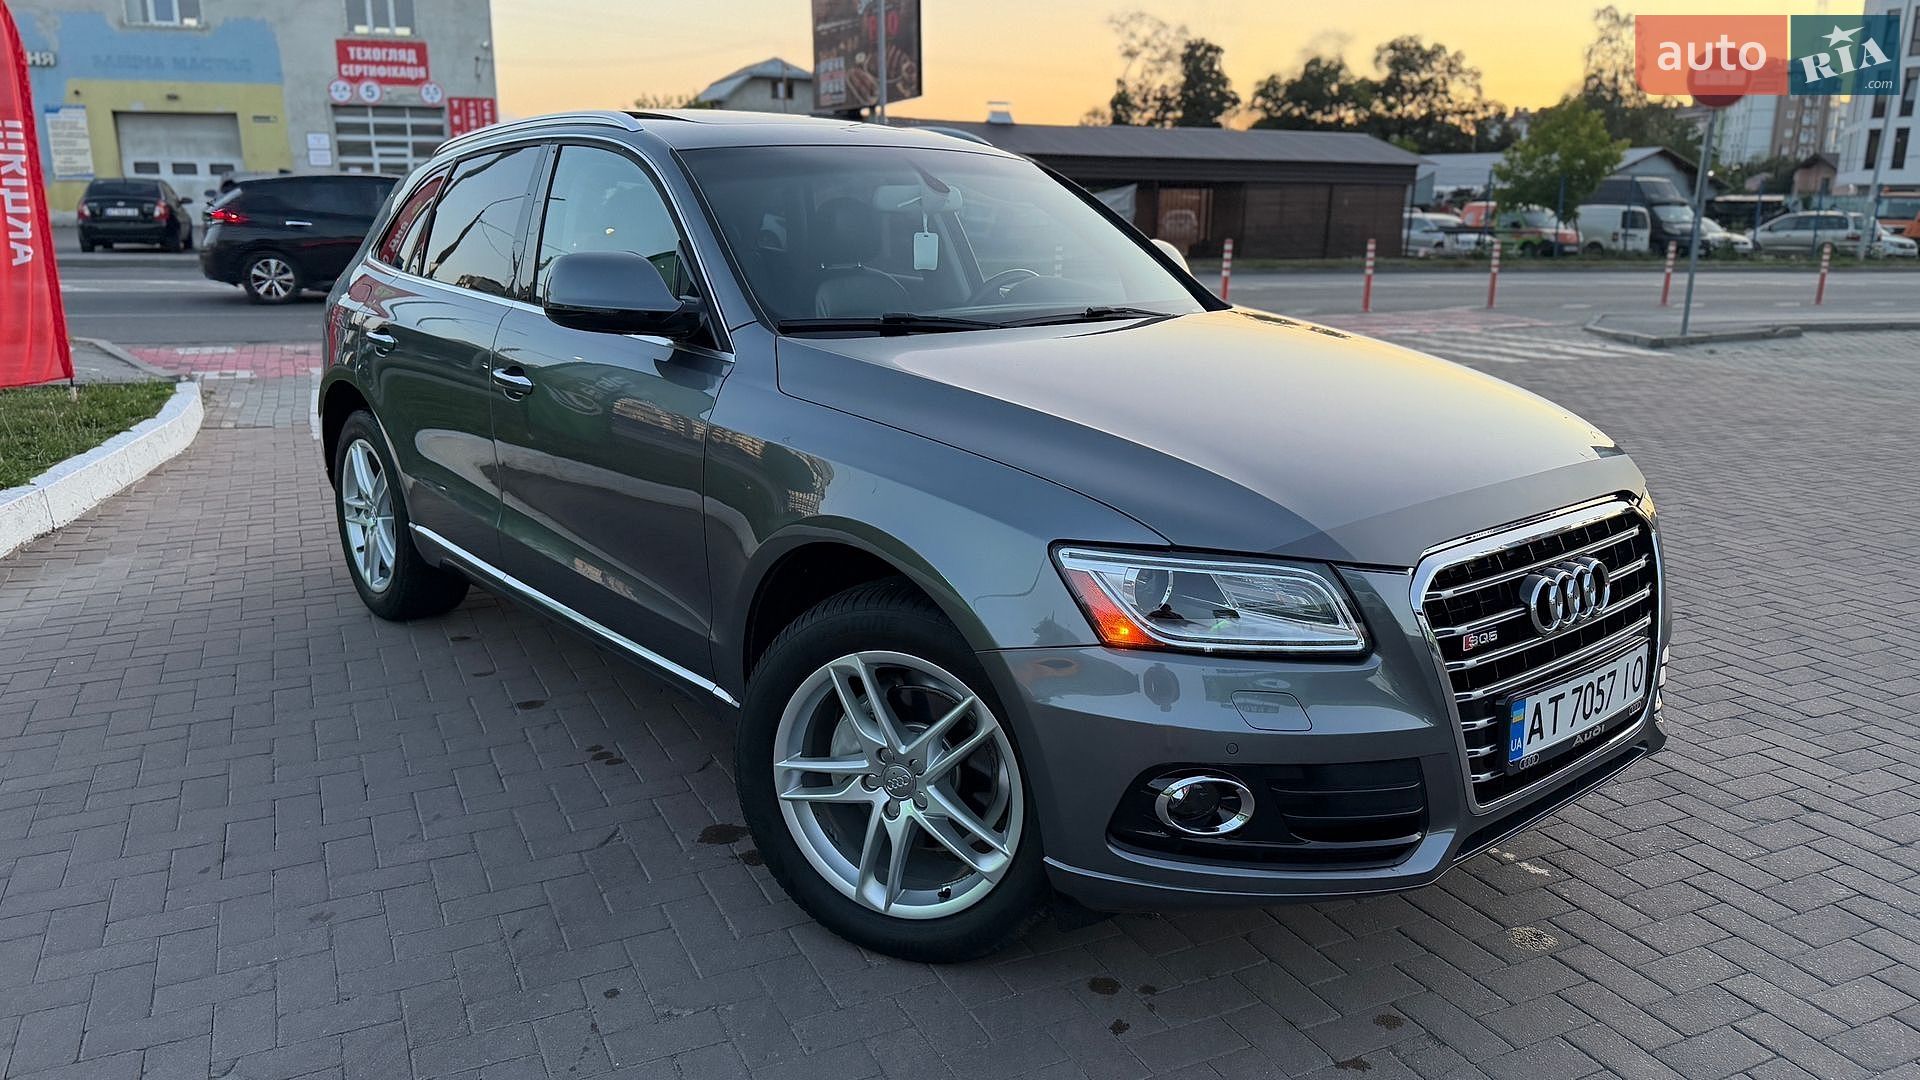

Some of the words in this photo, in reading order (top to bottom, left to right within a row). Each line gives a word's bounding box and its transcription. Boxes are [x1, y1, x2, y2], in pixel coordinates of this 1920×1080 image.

[26, 50, 56, 67] НЯ
[347, 46, 418, 64] ТЕХОГЛЯД
[341, 63, 427, 80] СЕРТИФІКАЦІЯ
[365, 85, 376, 98] 5
[1527, 692, 1566, 746] AT
[1570, 669, 1617, 728] 7057
[1623, 655, 1644, 700] IO
[1510, 737, 1523, 752] UA
